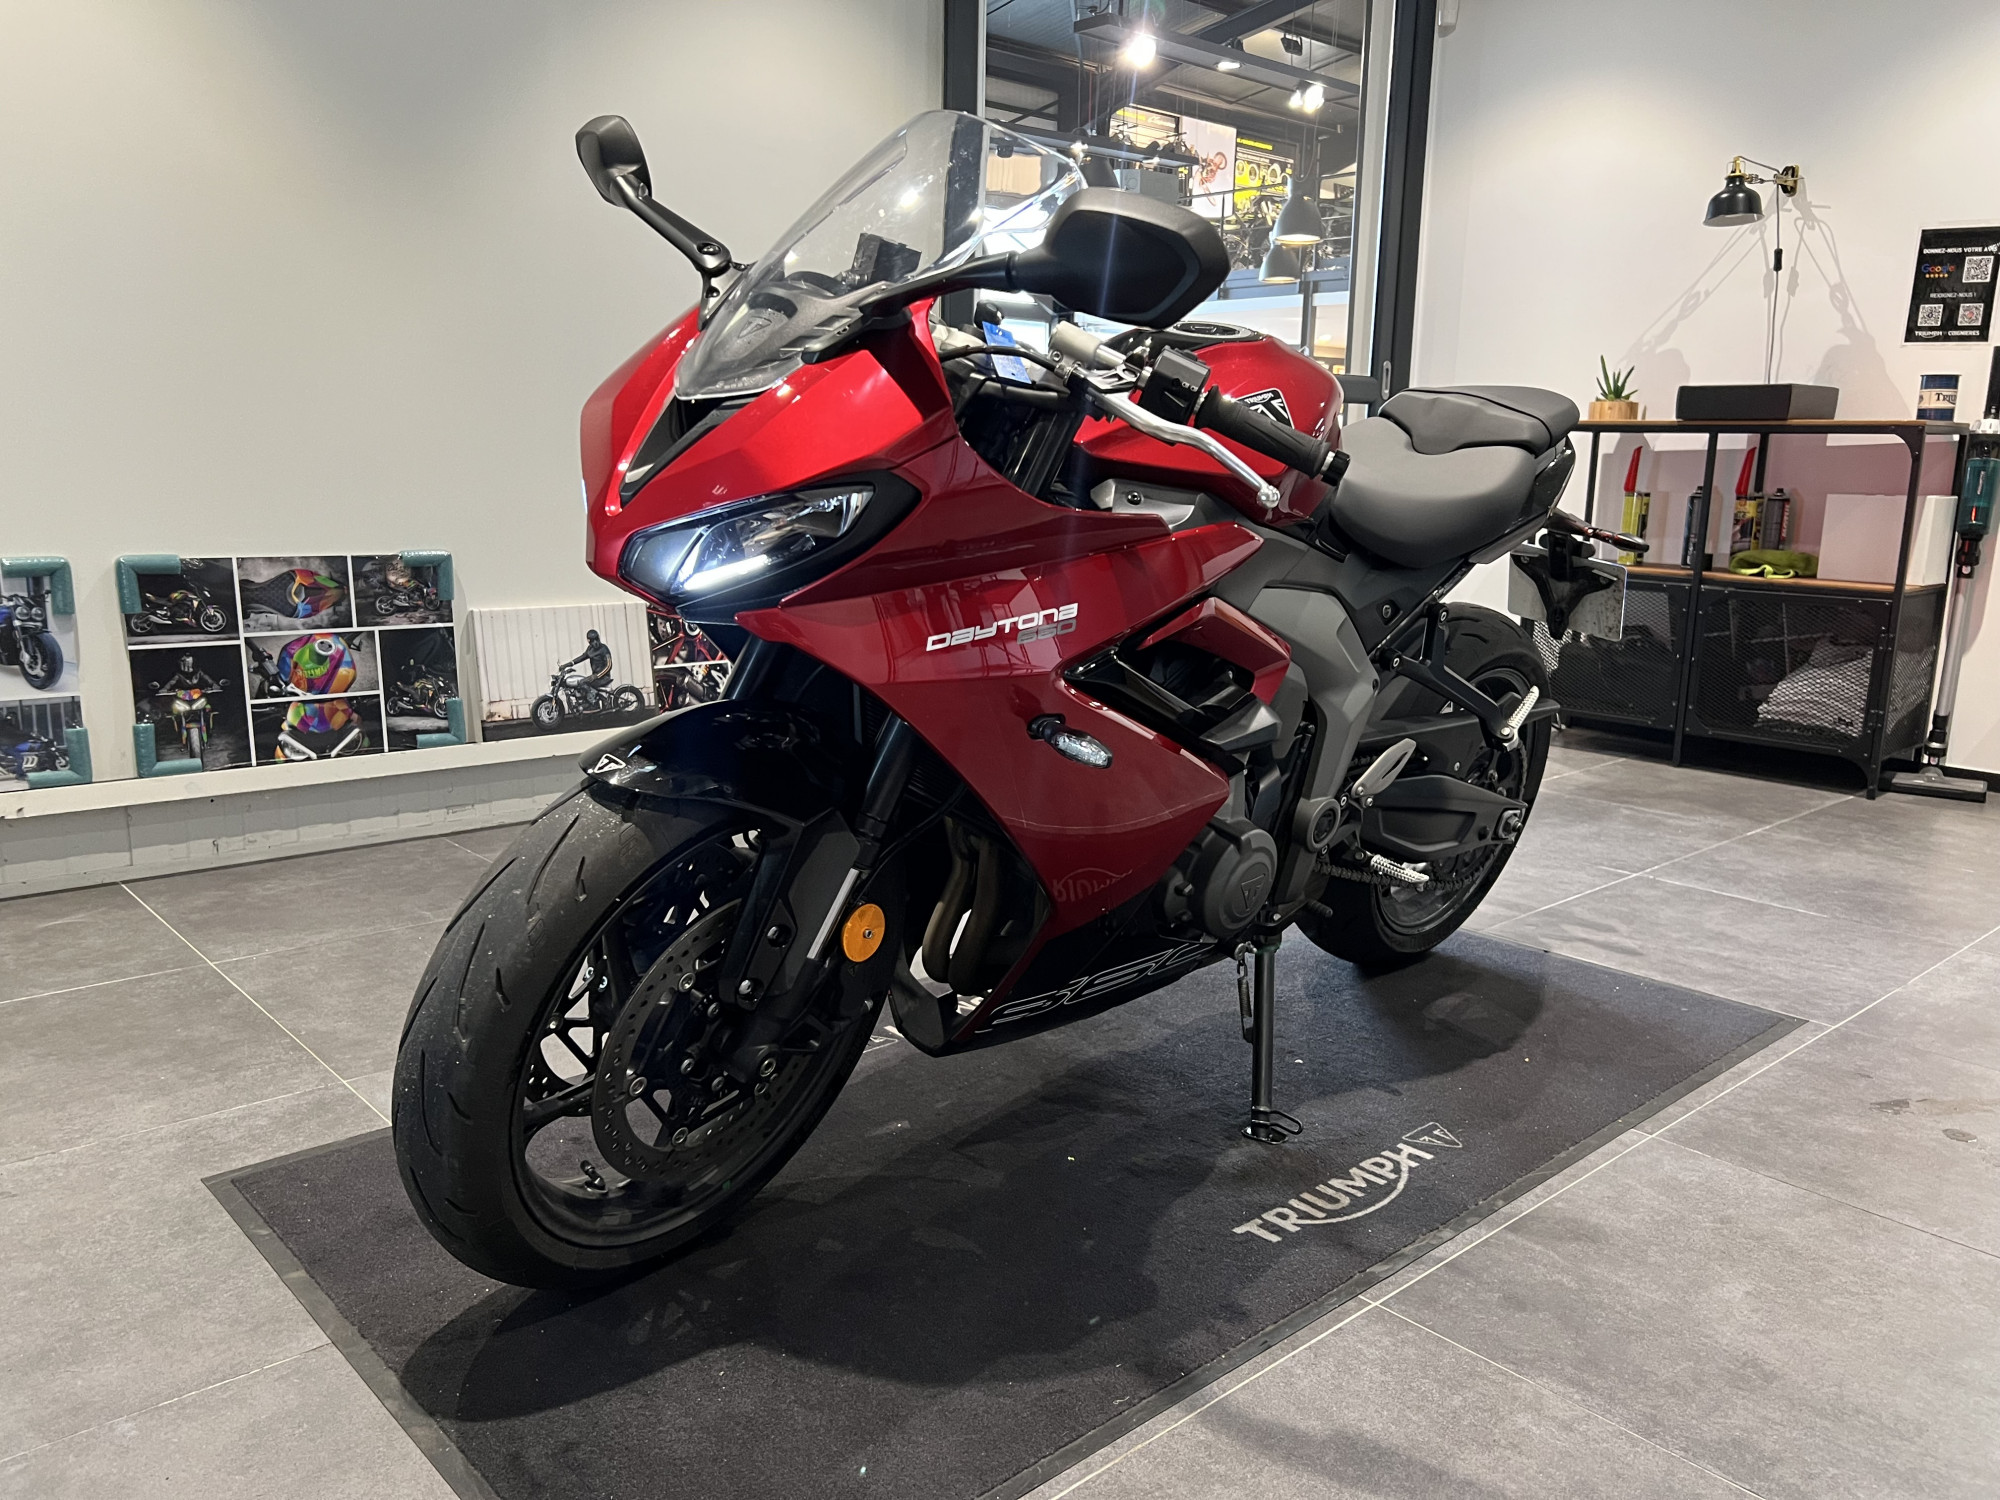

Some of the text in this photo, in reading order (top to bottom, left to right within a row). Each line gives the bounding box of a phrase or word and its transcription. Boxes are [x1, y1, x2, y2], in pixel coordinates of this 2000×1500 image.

[1921, 264, 1955, 273] Google
[1244, 392, 1274, 404] TRIUMPH
[1017, 619, 1076, 644] 660
[1232, 1143, 1434, 1243] TRIUMPH
